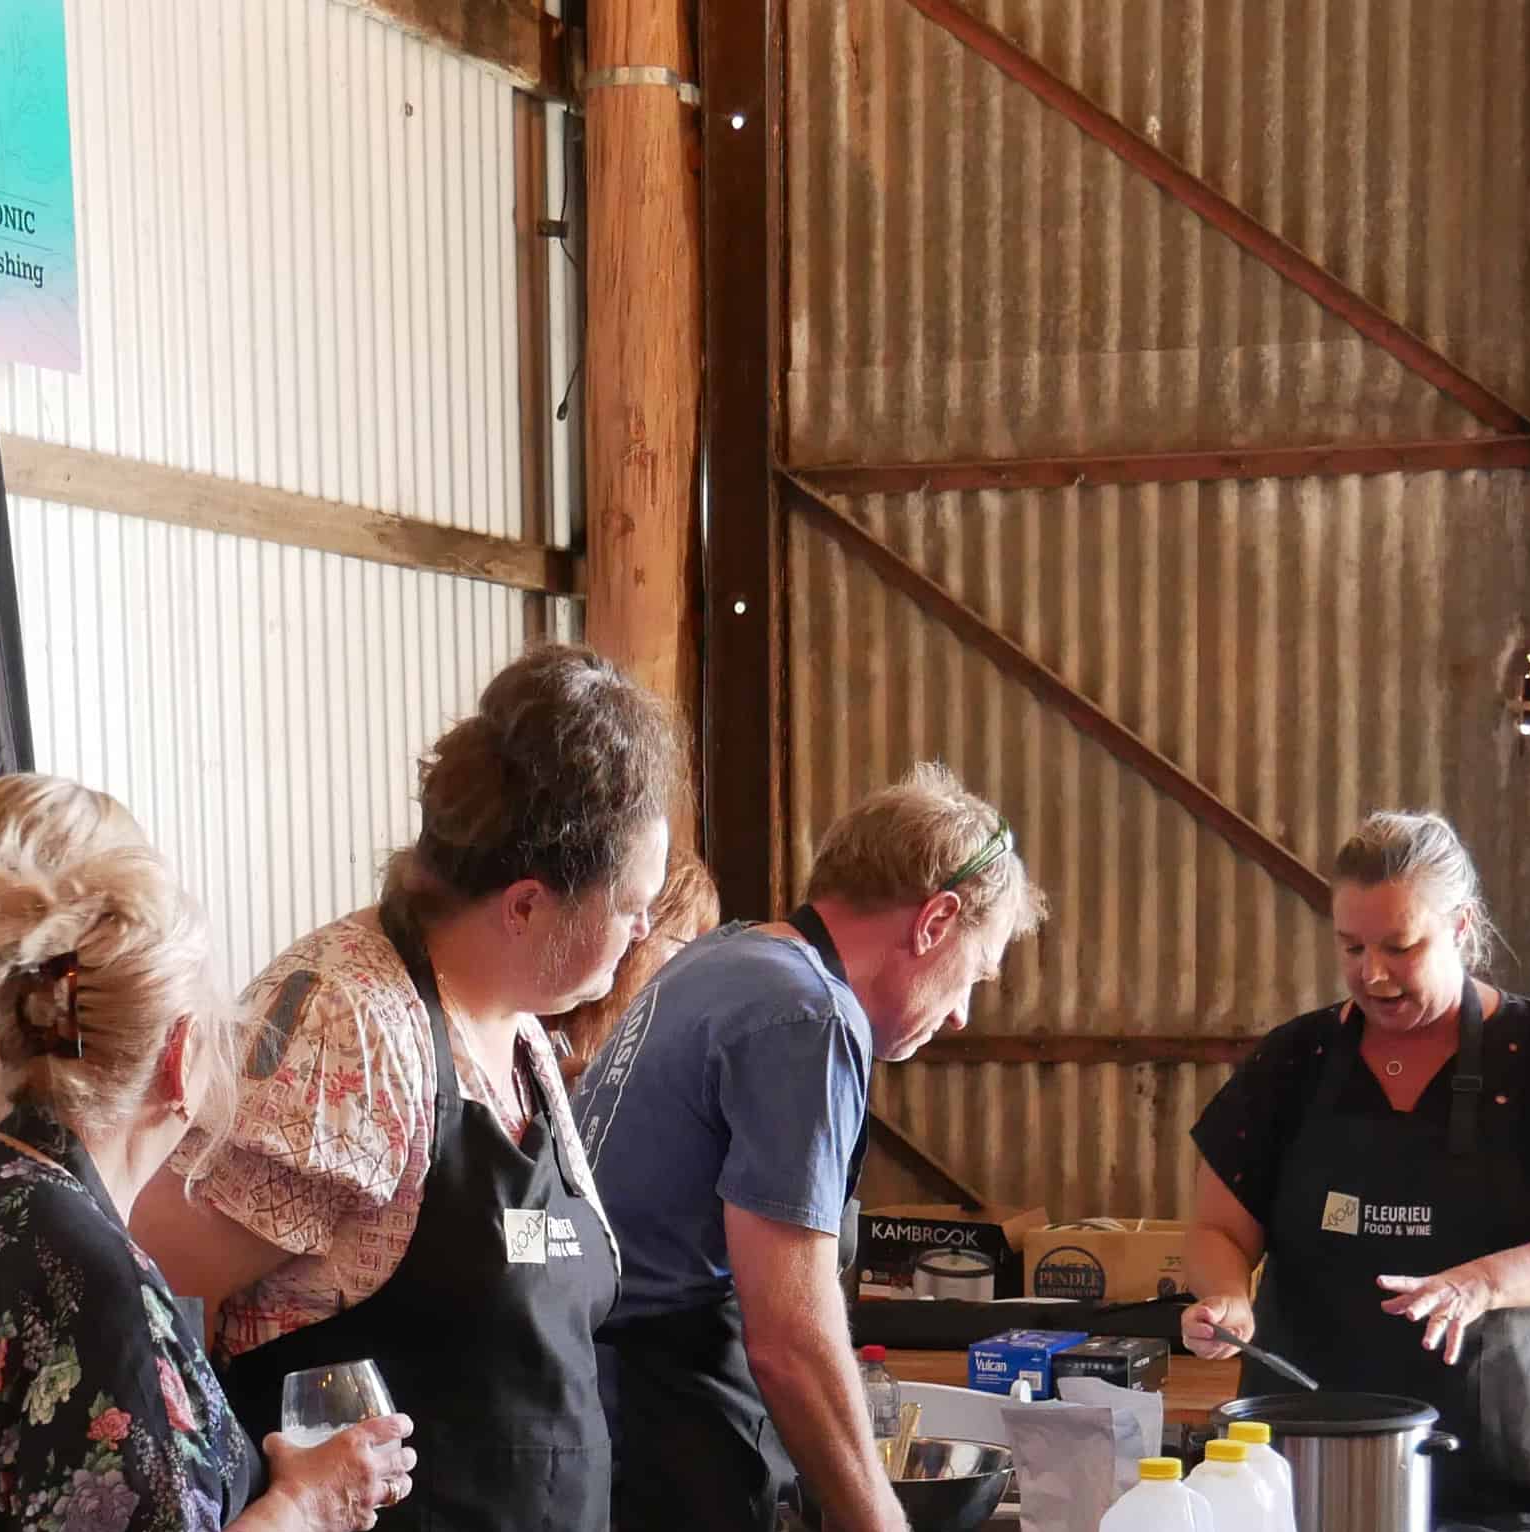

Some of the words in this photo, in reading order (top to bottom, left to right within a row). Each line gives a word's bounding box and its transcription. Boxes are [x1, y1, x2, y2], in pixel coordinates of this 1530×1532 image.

[1364, 1204, 1431, 1223] FLEURIEU
[871, 1222, 979, 1247] KAMBROOK
[1364, 1221, 1392, 1236] FOOD
[1406, 1224, 1432, 1236] WINE
[975, 1357, 1007, 1373] Vulcan
